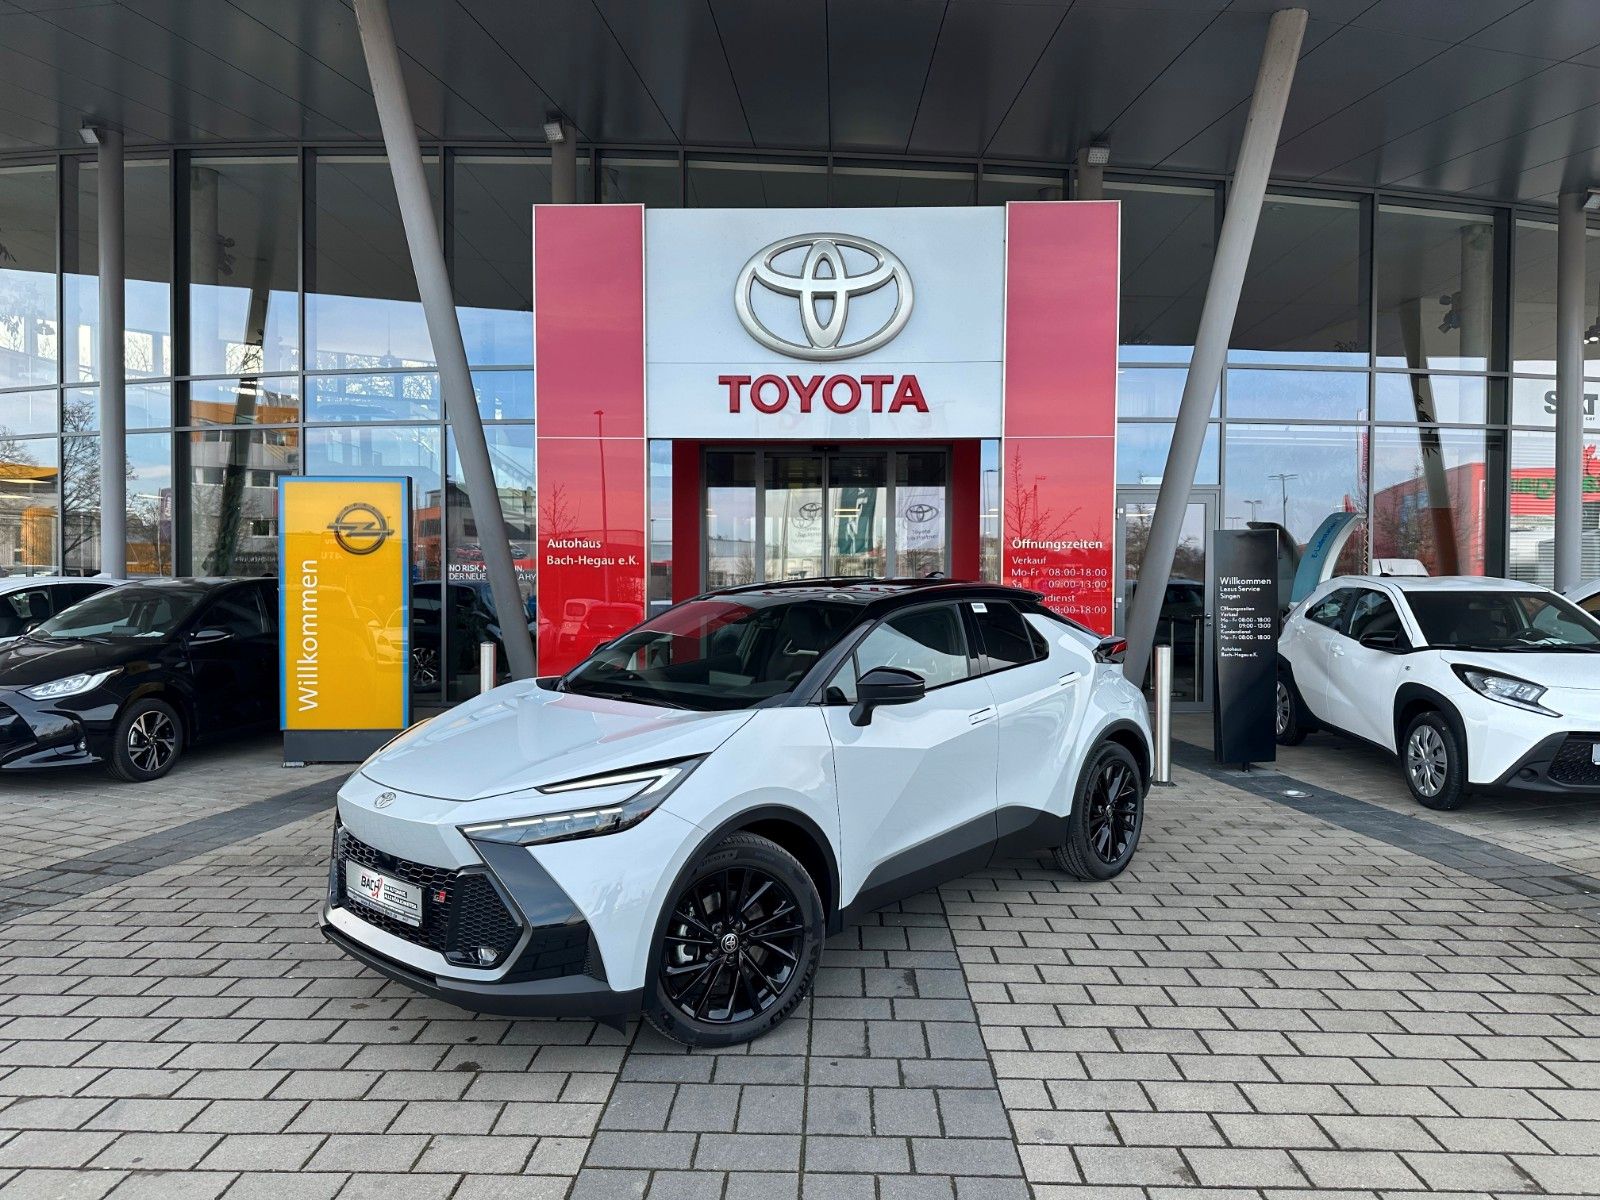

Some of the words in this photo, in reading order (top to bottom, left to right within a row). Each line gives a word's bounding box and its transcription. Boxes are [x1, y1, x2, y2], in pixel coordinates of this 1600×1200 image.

[718, 374, 930, 414] TOYOTA
[1544, 390, 1599, 415] ST
[546, 537, 602, 549] Autohaus
[1011, 537, 1103, 551] Öffnungszeiten
[546, 555, 615, 568] Bach-Hegau
[618, 555, 640, 565] e.K.
[1011, 556, 1047, 565] Verkauf
[449, 564, 461, 572] NO
[462, 564, 482, 573] RISK,
[1011, 568, 1040, 577] Mo-Fr
[1048, 568, 1107, 577] 08:00-18:00
[1219, 577, 1272, 585] Willkommen
[296, 559, 319, 713] Willkommen
